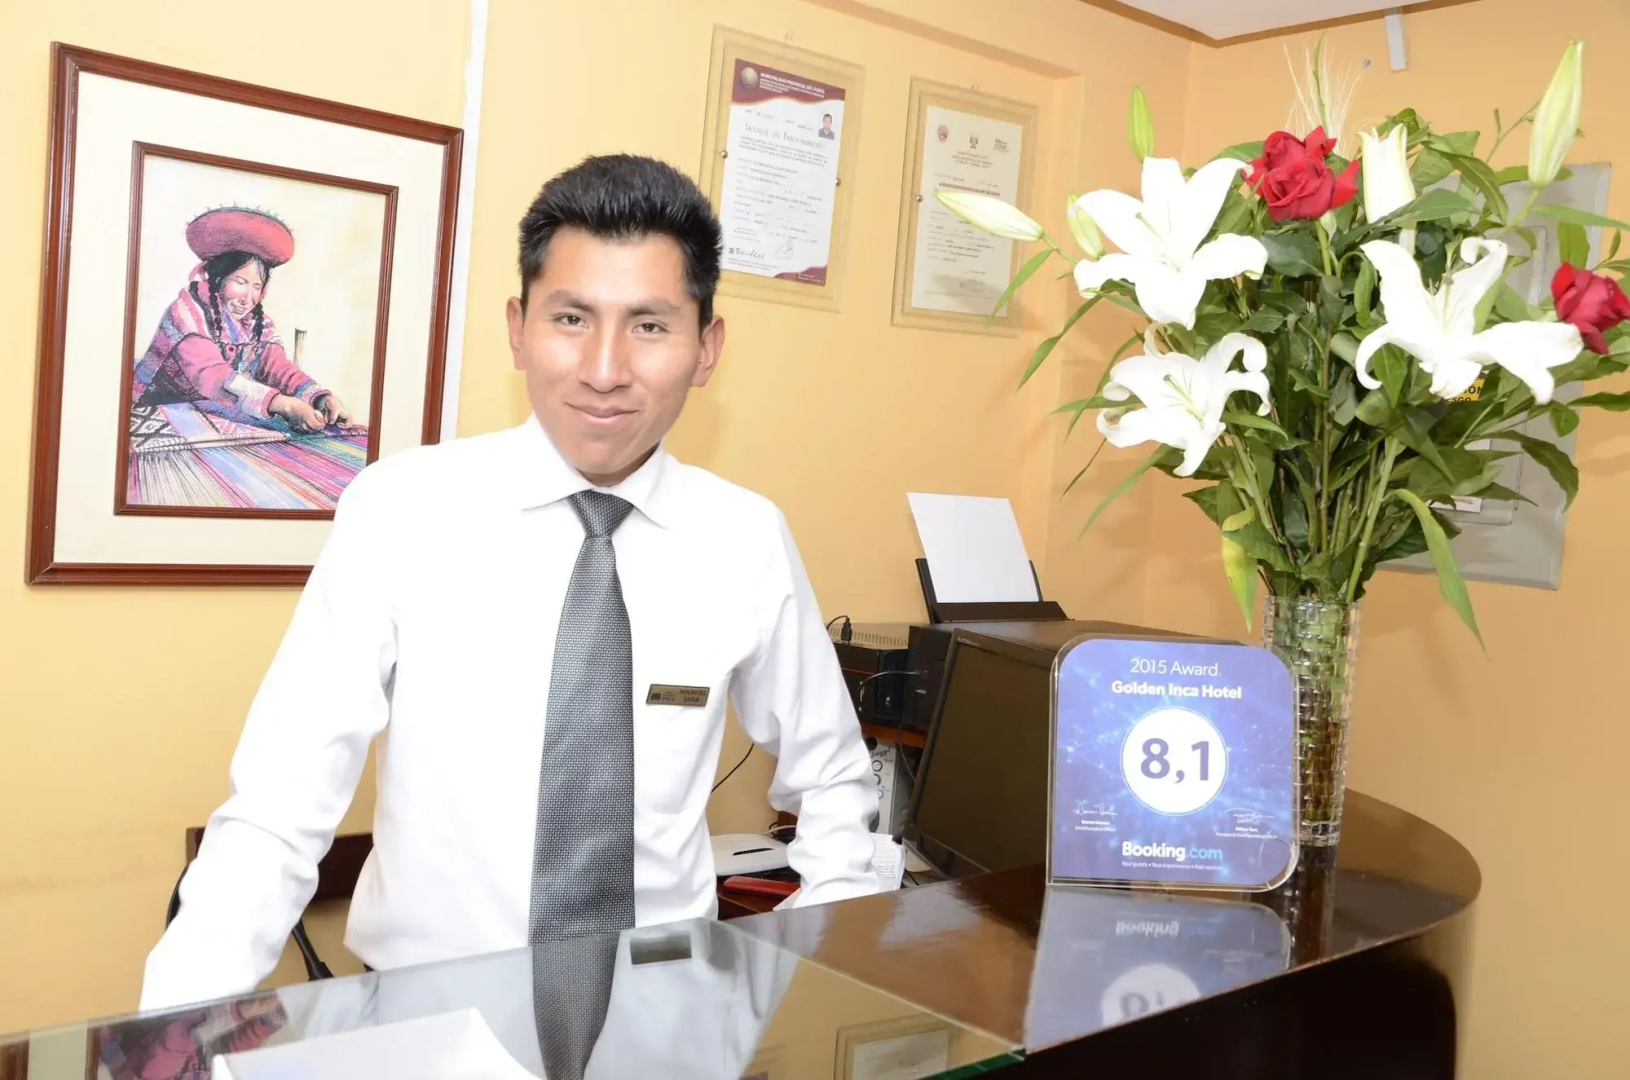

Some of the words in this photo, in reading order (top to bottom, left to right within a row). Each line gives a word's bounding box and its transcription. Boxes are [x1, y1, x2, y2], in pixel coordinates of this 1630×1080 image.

[1130, 659, 1167, 674] 2015
[1111, 680, 1166, 696] Golden
[1168, 683, 1199, 697] Inca
[1201, 685, 1243, 699] Hotel
[1140, 737, 1210, 784] 8,1
[1122, 841, 1223, 862] Booking.com
